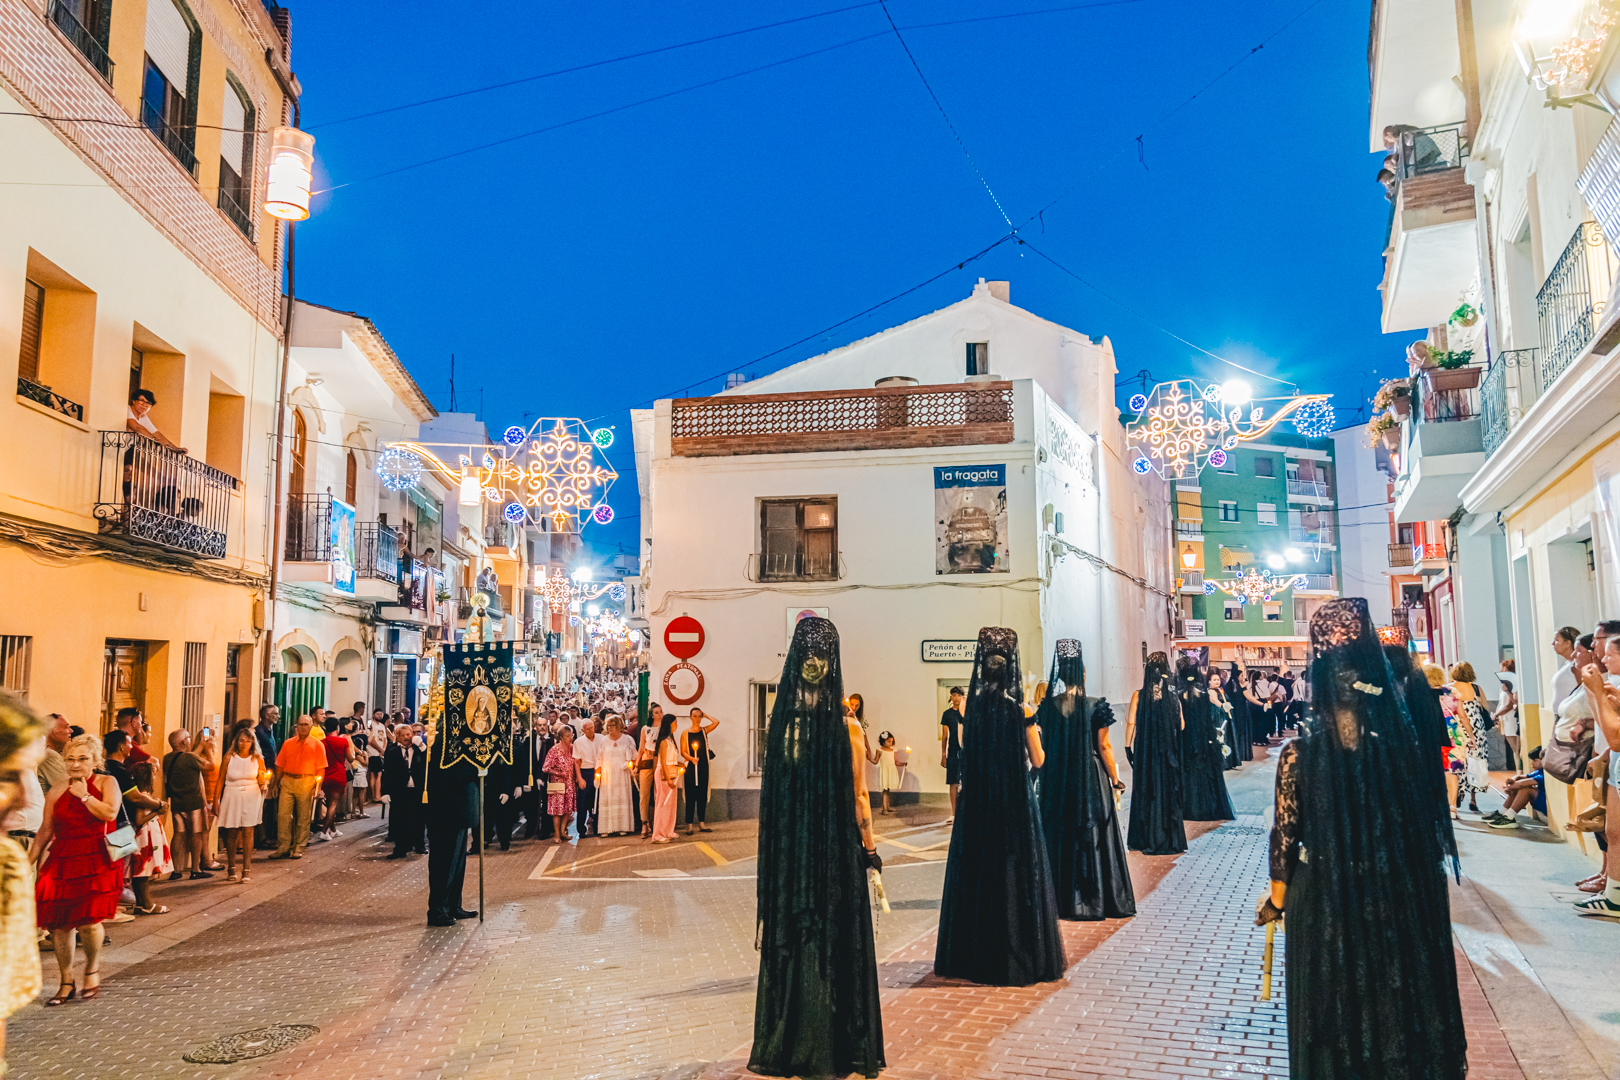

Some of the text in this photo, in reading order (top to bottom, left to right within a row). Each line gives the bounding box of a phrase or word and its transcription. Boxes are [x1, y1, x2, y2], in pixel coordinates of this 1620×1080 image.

[941, 469, 998, 482] la fragata
[664, 664, 701, 686] ZONA PEATONAL
